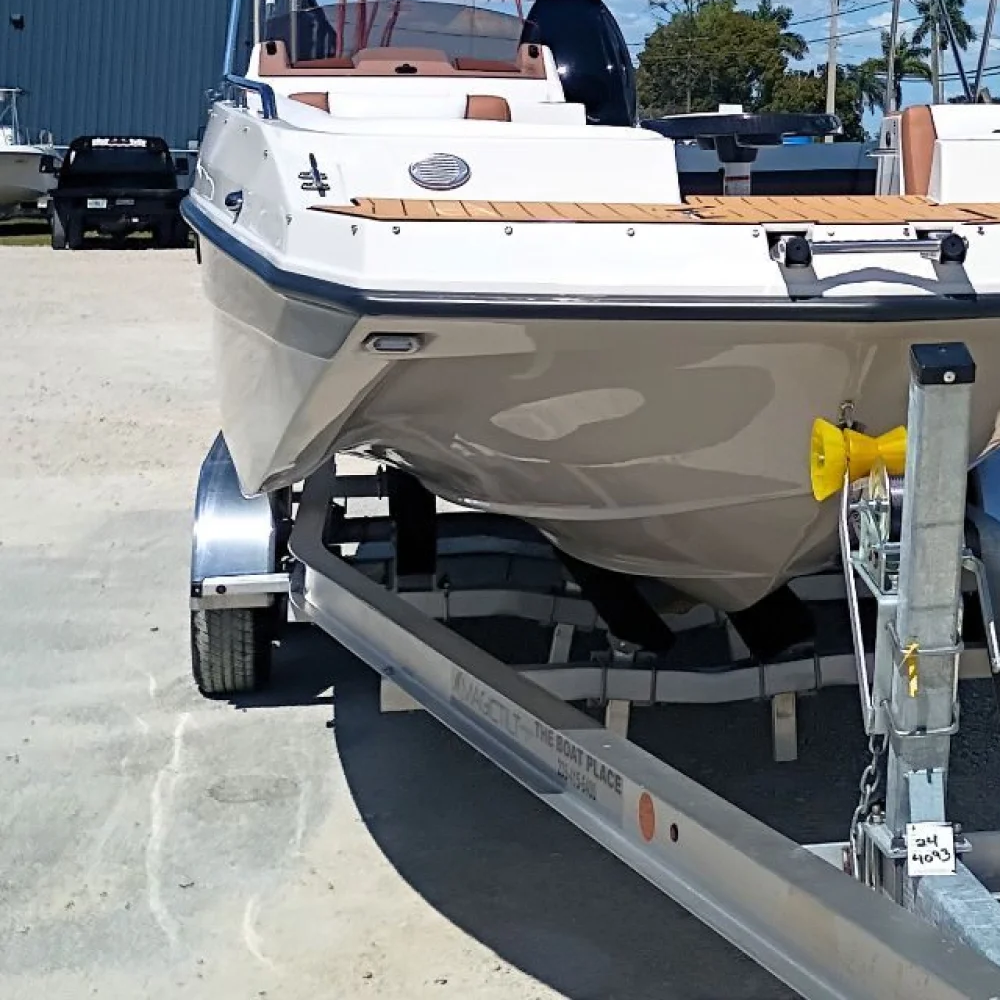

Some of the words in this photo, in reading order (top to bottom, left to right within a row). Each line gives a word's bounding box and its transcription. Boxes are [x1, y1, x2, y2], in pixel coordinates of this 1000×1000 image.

[555, 733, 584, 767] BOAT
[586, 754, 623, 795] PLACE
[915, 834, 938, 848] 24
